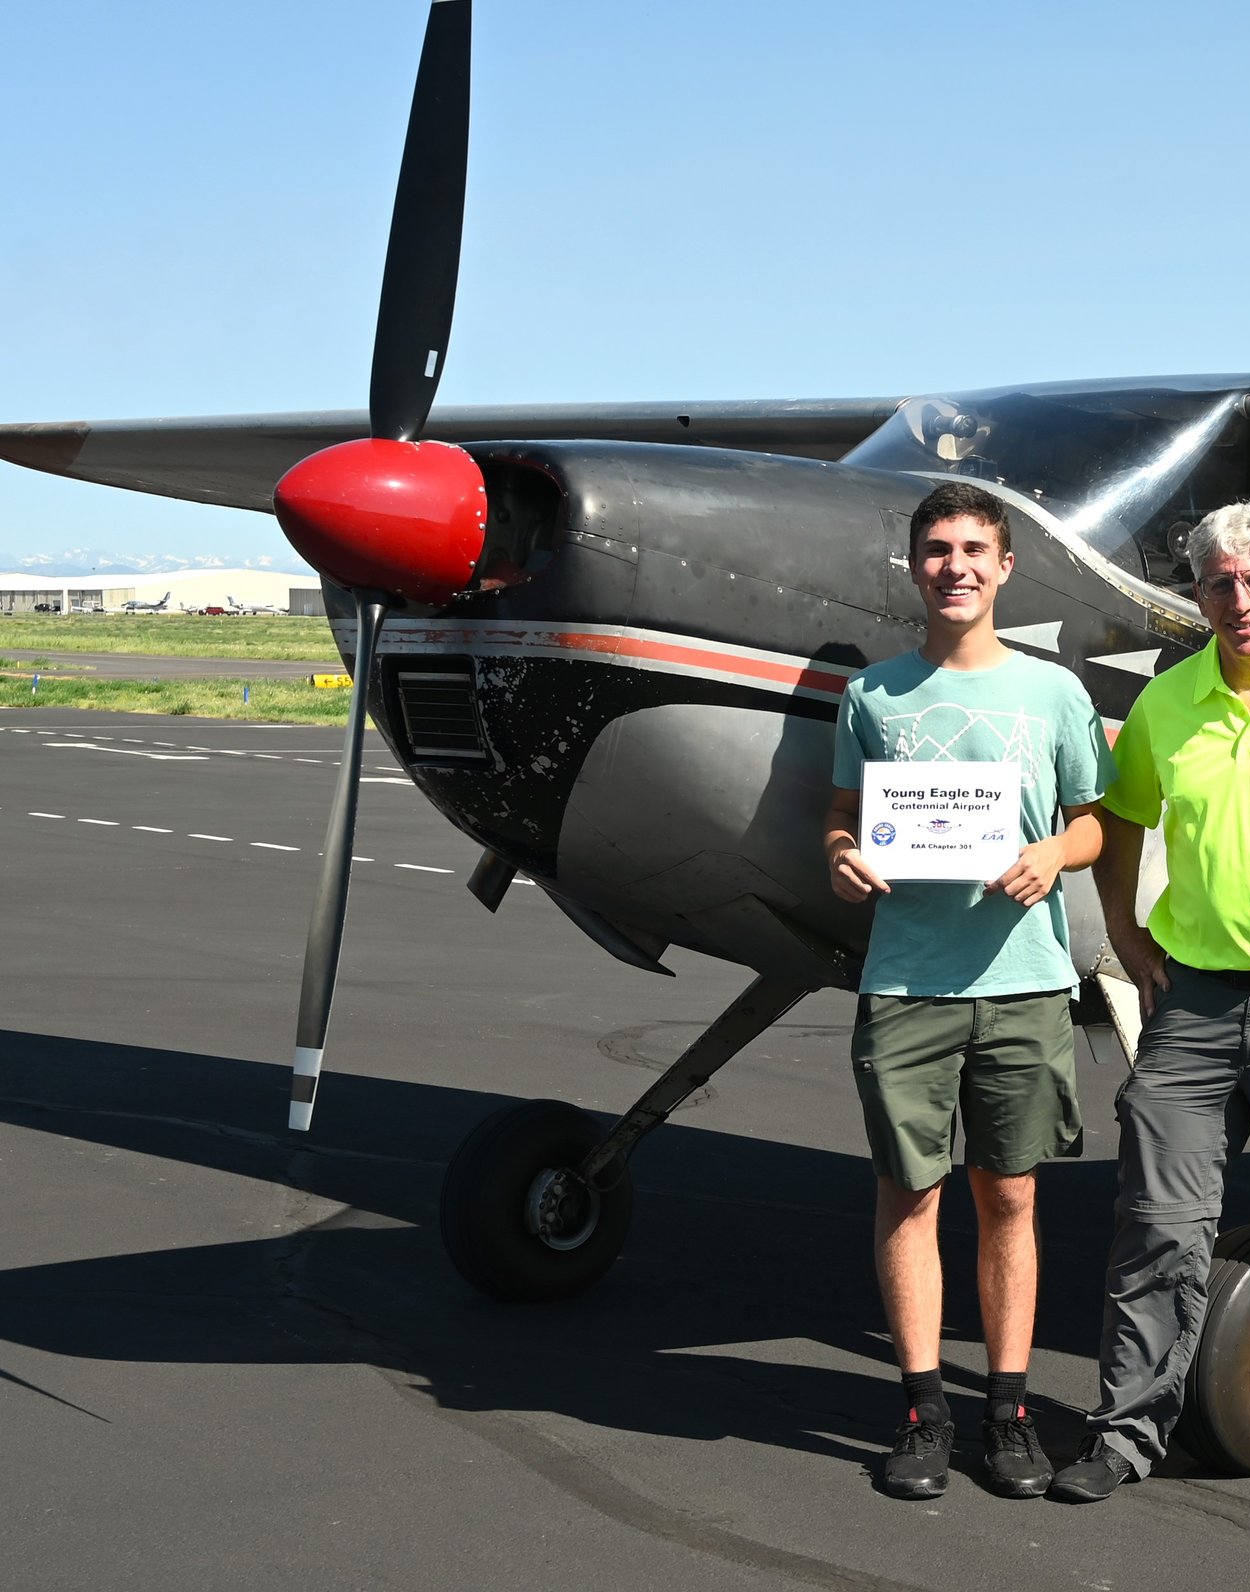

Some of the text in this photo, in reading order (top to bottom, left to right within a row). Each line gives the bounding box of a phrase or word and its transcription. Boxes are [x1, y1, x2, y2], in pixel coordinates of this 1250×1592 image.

[336, 676, 352, 687] S5
[883, 788, 1002, 802] Young Eagle Day
[891, 802, 991, 812] Centennial Airport
[981, 833, 1004, 841] EAA
[928, 843, 957, 851] Chapter
